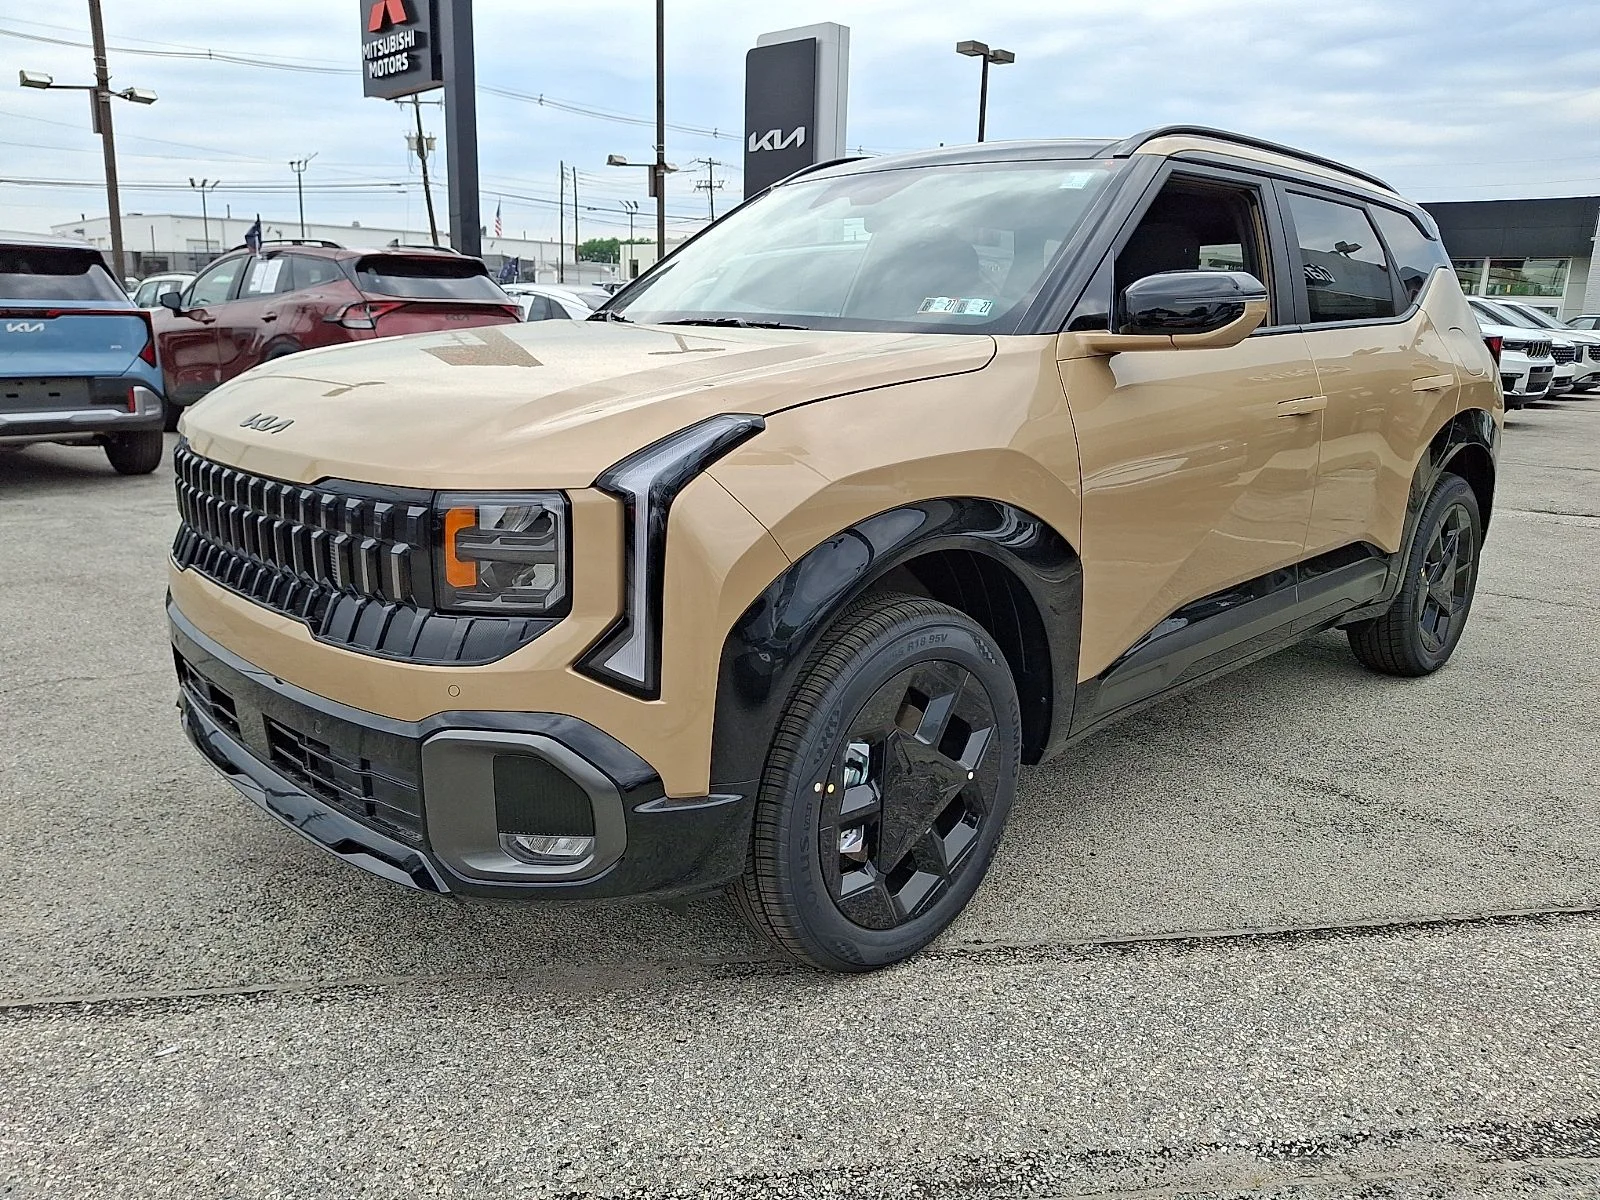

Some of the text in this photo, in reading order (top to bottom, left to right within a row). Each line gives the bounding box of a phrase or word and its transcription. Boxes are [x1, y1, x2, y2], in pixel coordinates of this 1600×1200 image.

[362, 29, 415, 60] MITSUBISHI
[368, 52, 409, 79] MOTORS
[748, 126, 806, 152] KIA
[944, 299, 956, 311] 27
[979, 301, 992, 313] 27
[6, 322, 45, 333] KIA
[240, 412, 295, 435] KIA
[928, 633, 948, 644] 95V
